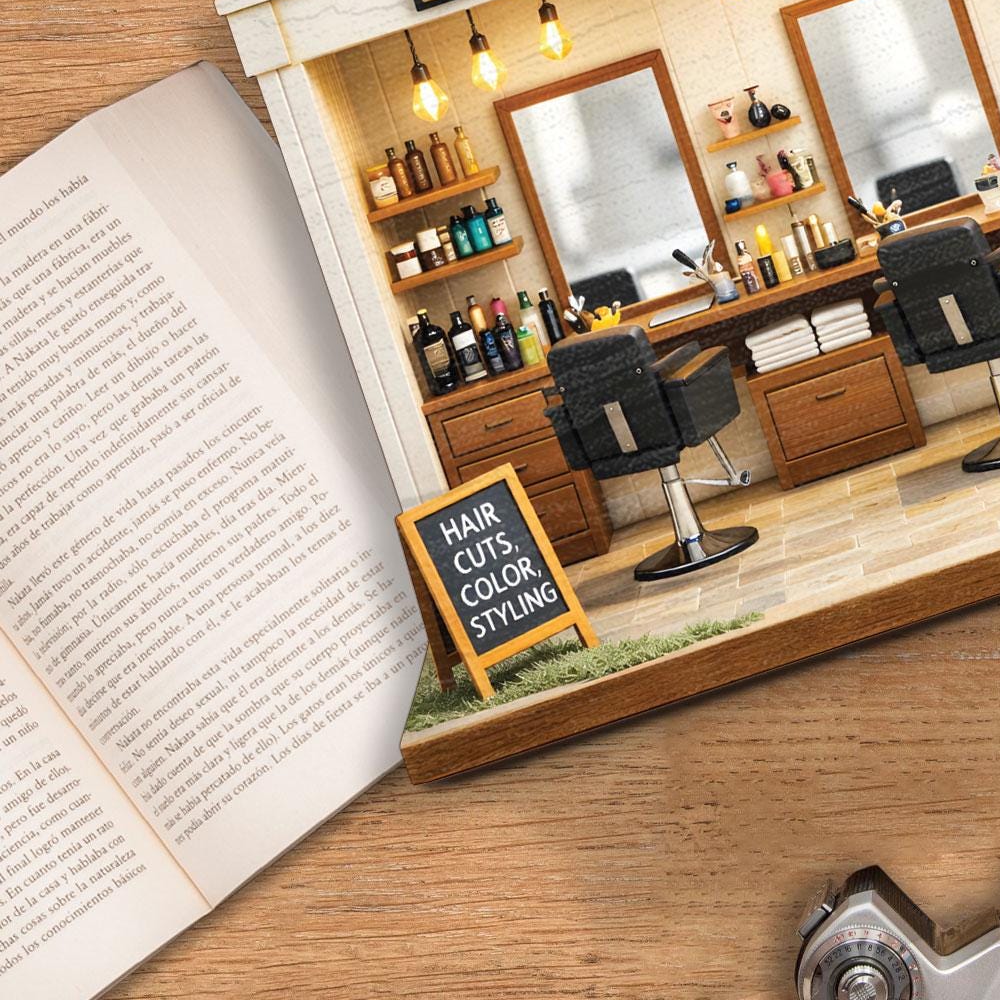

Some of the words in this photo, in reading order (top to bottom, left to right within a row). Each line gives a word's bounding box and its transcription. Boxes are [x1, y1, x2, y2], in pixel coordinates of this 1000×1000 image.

[7, 207, 43, 237] mundo
[42, 196, 60, 209] los
[58, 175, 88, 198] había
[11, 249, 49, 278] madera
[48, 238, 63, 250] en
[63, 223, 83, 240] una
[82, 205, 109, 226] fábri-
[2, 300, 39, 330] madera
[46, 286, 58, 297] se
[55, 262, 91, 289] hacían
[91, 232, 132, 264] muebles
[12, 338, 49, 367] Nakata
[47, 329, 60, 340] le
[60, 307, 88, 334] gustó
[88, 273, 136, 311] enseguida
[135, 262, 152, 276] tra-
[8, 434, 42, 464] aprecio
[52, 402, 86, 429] cariño.
[85, 382, 109, 402] Leer
[110, 371, 126, 384] un
[126, 346, 159, 372] dibujo
[168, 317, 197, 341] hacer
[29, 406, 50, 423] una
[49, 378, 86, 410] palabra
[87, 367, 100, 380] de
[101, 350, 126, 369] más,
[126, 338, 137, 350] el
[137, 316, 169, 342] dueño
[170, 300, 187, 318] del
[2, 504, 14, 515] la
[13, 465, 65, 509] perfección.
[64, 444, 88, 463] Una
[89, 430, 106, 444] vez
[109, 414, 128, 431] que
[130, 384, 169, 418] grababa
[169, 372, 185, 386] un
[186, 346, 220, 376] patrón
[6, 584, 32, 608] Nakata
[29, 565, 51, 587] llevó
[51, 552, 69, 569] este
[70, 526, 102, 556] género
[102, 515, 115, 528] de
[115, 497, 138, 516] vida
[136, 477, 165, 499] hasta
[165, 447, 204, 482] pasados
[202, 436, 221, 450] los
[221, 405, 262, 438] cincuen-
[440, 502, 501, 545] HAIR
[454, 531, 519, 574] CUTS,
[82, 673, 95, 684] lo
[94, 641, 136, 676] apreciaba,
[134, 621, 156, 644] pero
[157, 596, 188, 623] nunca
[188, 579, 212, 598] tuvo
[212, 566, 228, 580] un
[227, 530, 276, 567] verdadero
[278, 505, 312, 532] amigo.
[310, 491, 328, 505] Po-
[110, 697, 122, 709] de
[121, 679, 141, 699] estar
[139, 645, 185, 682] hablando
[185, 629, 205, 647] con
[205, 618, 220, 631] él,
[220, 609, 231, 619] se
[229, 600, 242, 611] le
[244, 565, 290, 602] acababan
[288, 552, 307, 567] los
[307, 530, 337, 554] temas
[338, 519, 351, 531] de
[460, 556, 542, 607] COLOR,
[470, 581, 558, 639] STYLING
[115, 728, 142, 751] Nakata
[140, 718, 153, 731] no
[152, 678, 202, 721] encontraba
[201, 663, 221, 680] esta
[220, 646, 243, 664] vida
[243, 595, 310, 648] especialmente
[310, 566, 349, 596] solitaria
[358, 548, 372, 561] in-
[149, 777, 167, 795] dado
[166, 755, 193, 780] cuenta
[193, 745, 205, 758] de
[205, 730, 223, 748] que
[221, 723, 234, 733] la
[234, 694, 271, 725] sombra
[270, 678, 290, 696] que
[291, 668, 304, 680] su
[304, 642, 338, 671] cuerpo
[338, 601, 393, 646] proyectaba
[393, 590, 407, 603] en
[13, 905, 26, 917] de
[24, 896, 38, 907] la
[38, 879, 60, 898] casa
[67, 846, 108, 875] hablaba
[107, 834, 125, 849] con
[20, 912, 47, 935] cosas
[47, 890, 76, 914] sobre
[74, 882, 88, 892] la
[88, 849, 136, 884] naturaleza
[21, 940, 40, 955] los
[40, 886, 113, 942] conocimientos
[111, 864, 146, 888] básicos
